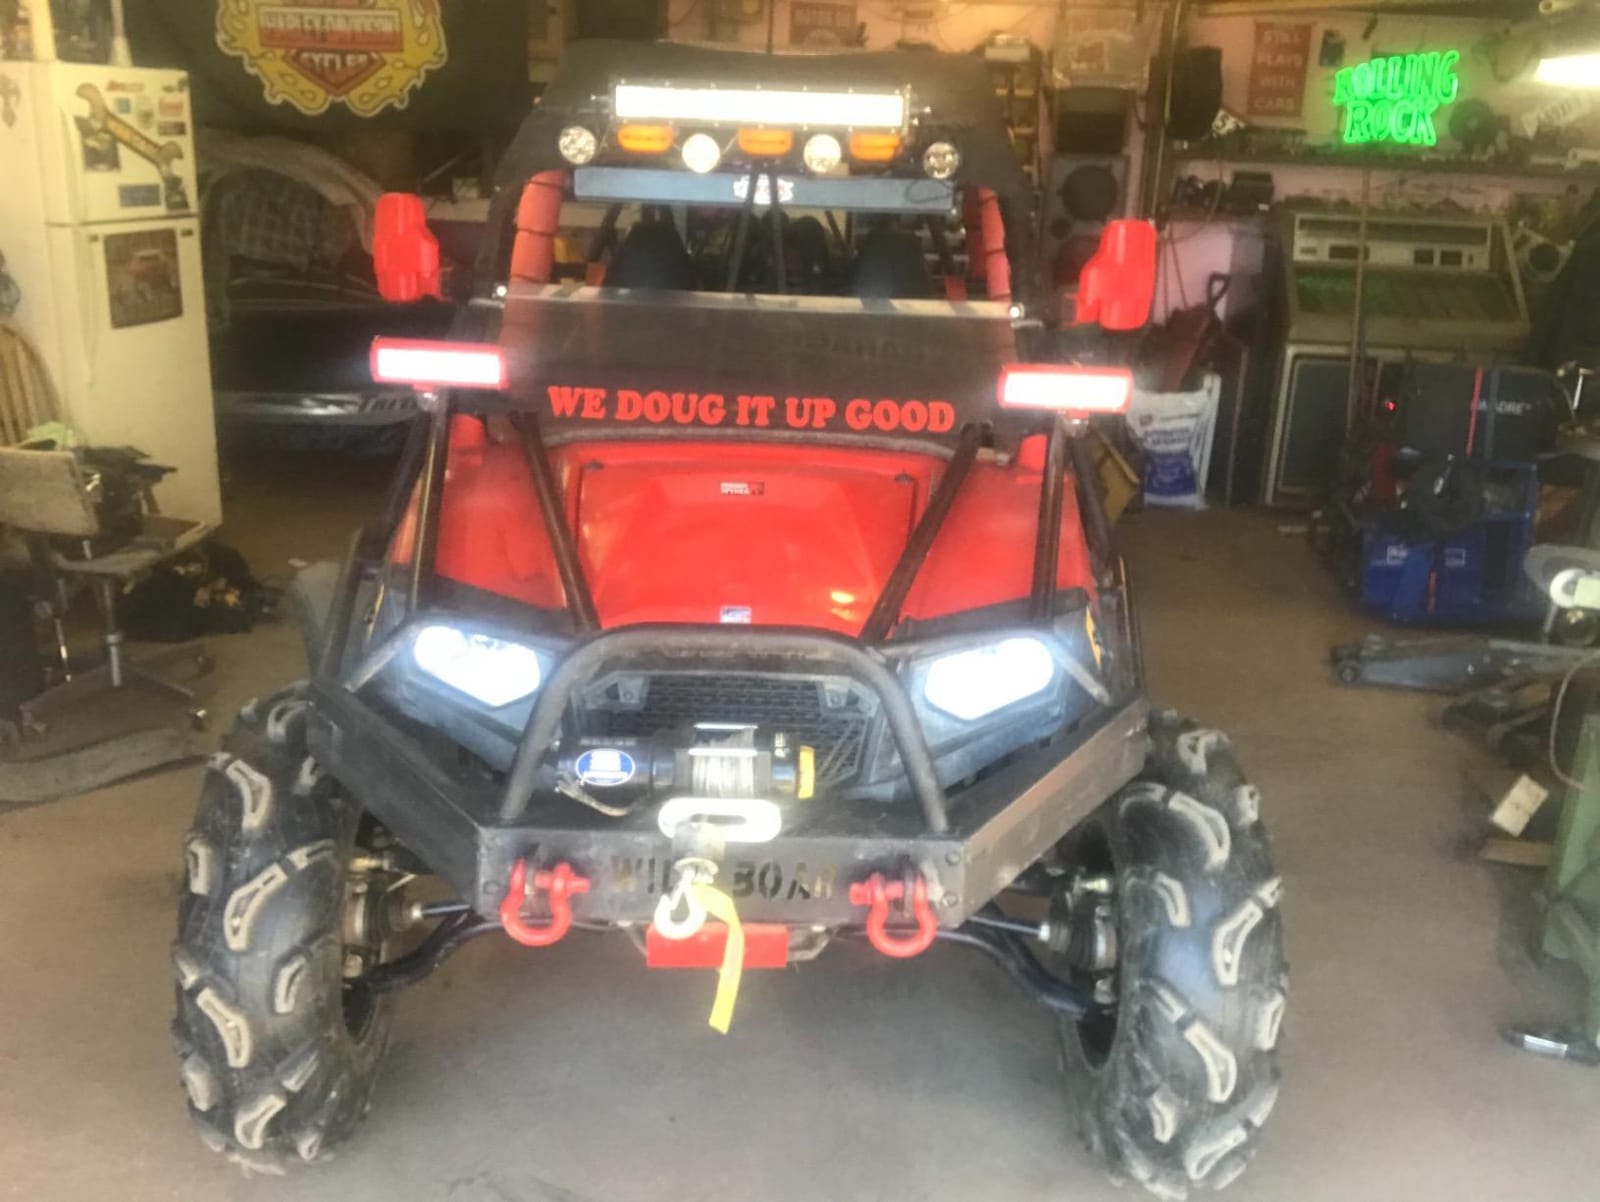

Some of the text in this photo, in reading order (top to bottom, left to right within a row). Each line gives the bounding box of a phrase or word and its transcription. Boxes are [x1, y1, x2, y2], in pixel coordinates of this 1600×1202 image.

[1333, 50, 1459, 106] ROLLING
[1343, 99, 1438, 146] ROCK
[547, 385, 955, 433] WE DOUG IT UP GOOD
